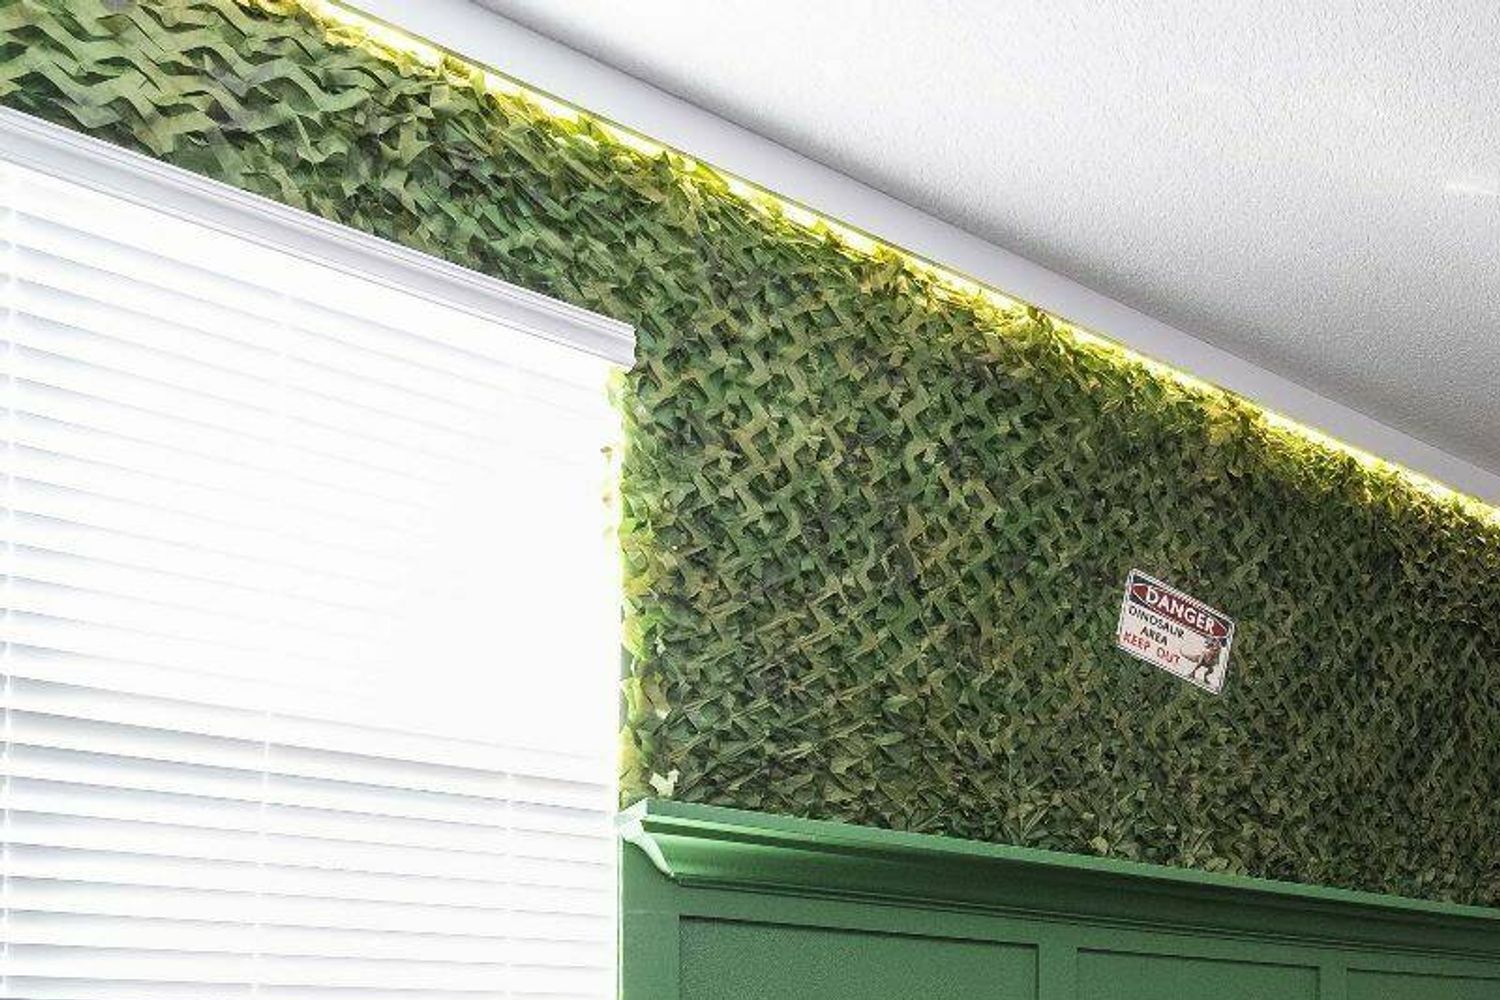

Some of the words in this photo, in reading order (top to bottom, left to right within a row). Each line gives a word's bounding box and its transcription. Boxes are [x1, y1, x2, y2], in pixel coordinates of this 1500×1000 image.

[1128, 606, 1184, 639] DINOSAUR
[1146, 585, 1214, 634] DANGER
[1122, 631, 1150, 651] KEEP
[1156, 647, 1180, 664] OUT
[1141, 626, 1168, 646] AREA
